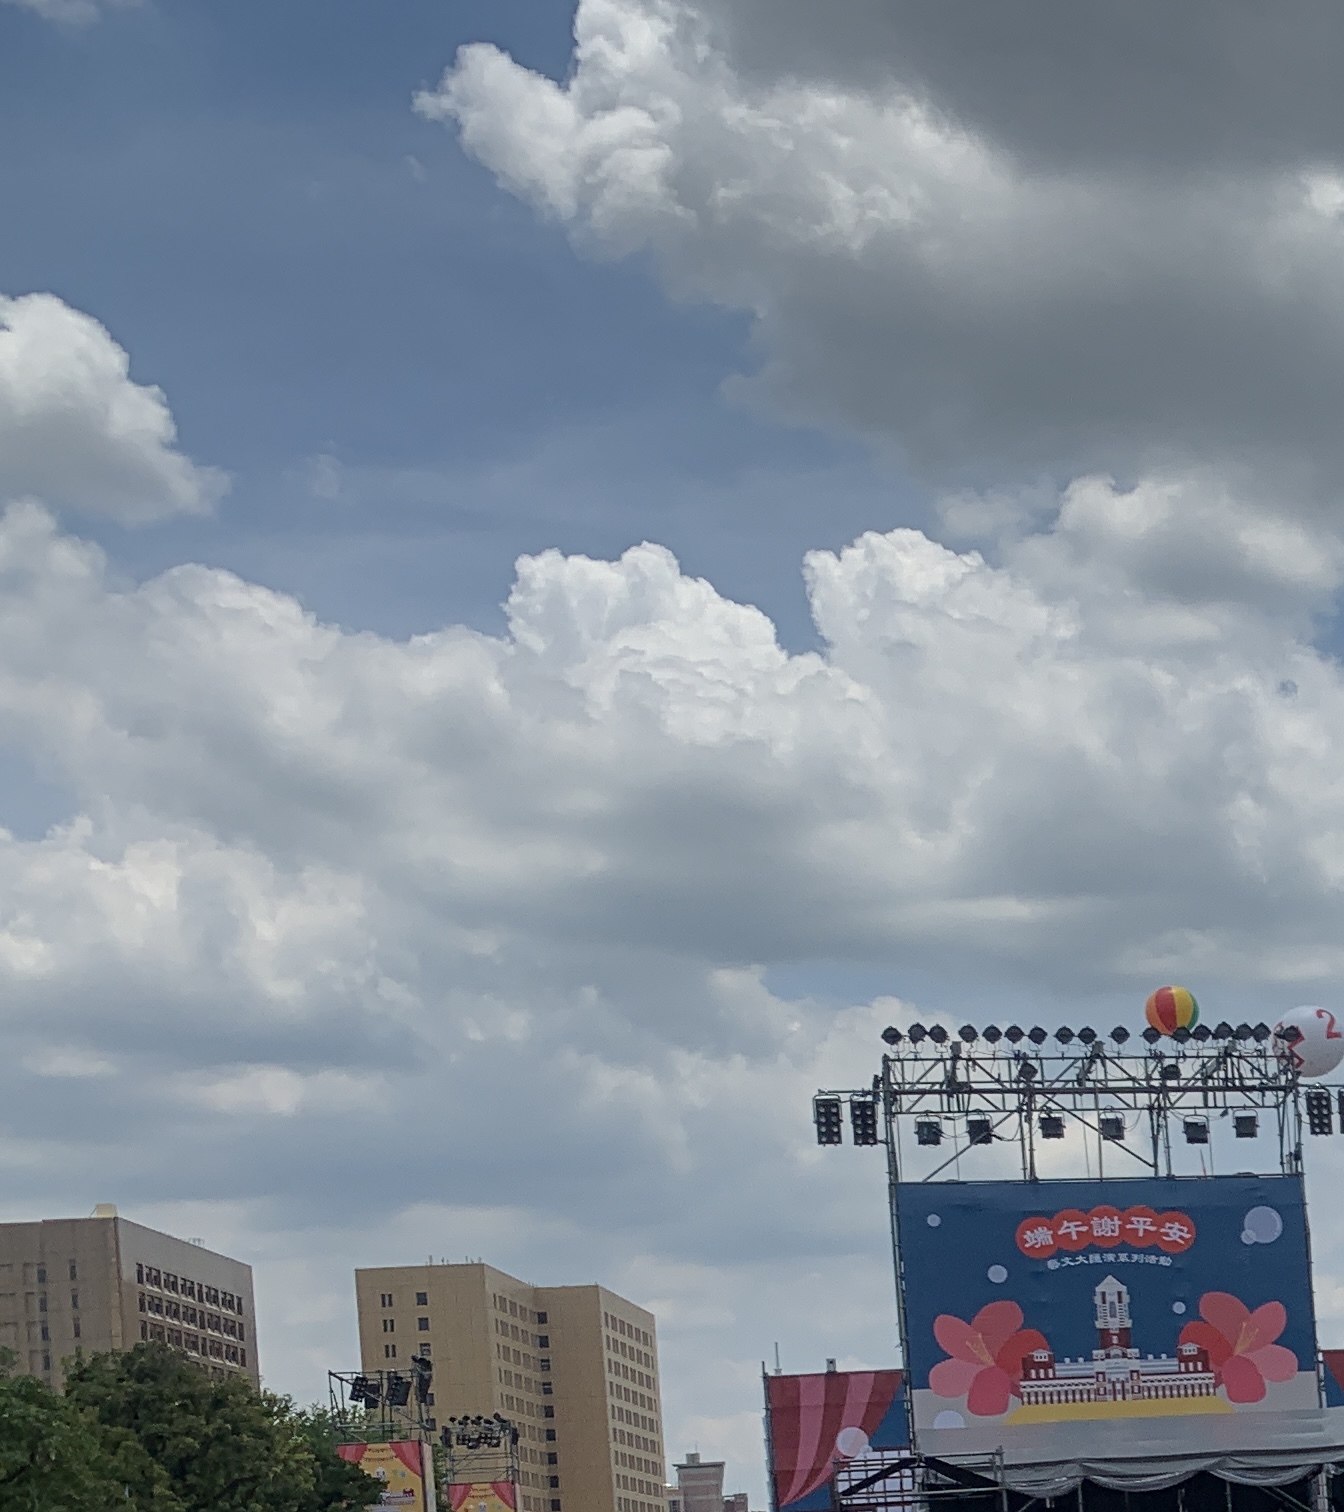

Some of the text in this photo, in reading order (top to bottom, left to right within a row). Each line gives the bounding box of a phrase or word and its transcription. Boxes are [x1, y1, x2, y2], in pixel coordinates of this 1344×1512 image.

[1316, 1009, 1342, 1039] 2
[1023, 1216, 1192, 1248] 端午謝平安
